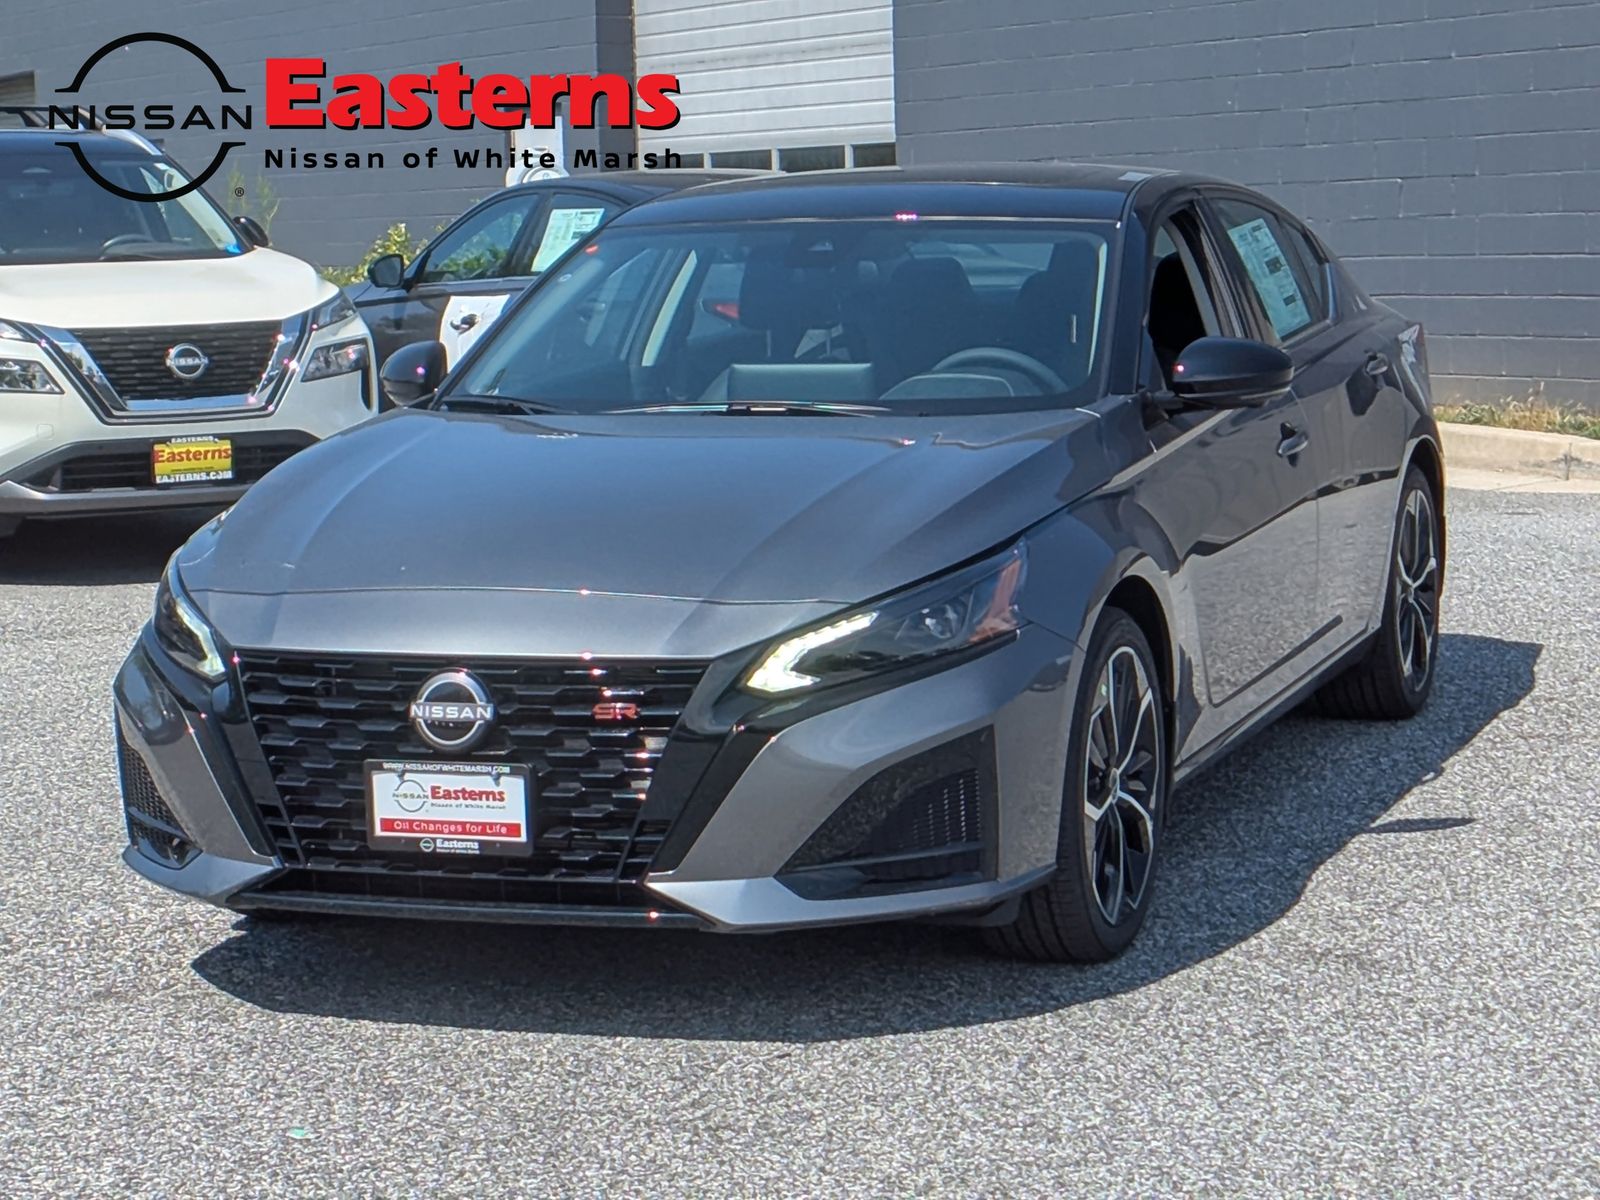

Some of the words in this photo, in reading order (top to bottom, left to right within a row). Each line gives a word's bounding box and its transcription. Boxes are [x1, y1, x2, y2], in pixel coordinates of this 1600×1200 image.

[165, 357, 209, 366] NISSAN
[153, 447, 232, 464] Easterns
[156, 470, 232, 484] EASTERNS.COM
[411, 703, 492, 719] NISSAN
[592, 702, 640, 720] SR
[392, 792, 429, 800] NISSAN
[430, 785, 505, 802] Easterns
[393, 820, 410, 831] Oil
[412, 821, 463, 833] Changes
[486, 824, 508, 834] Life
[436, 838, 479, 849] Easterns
